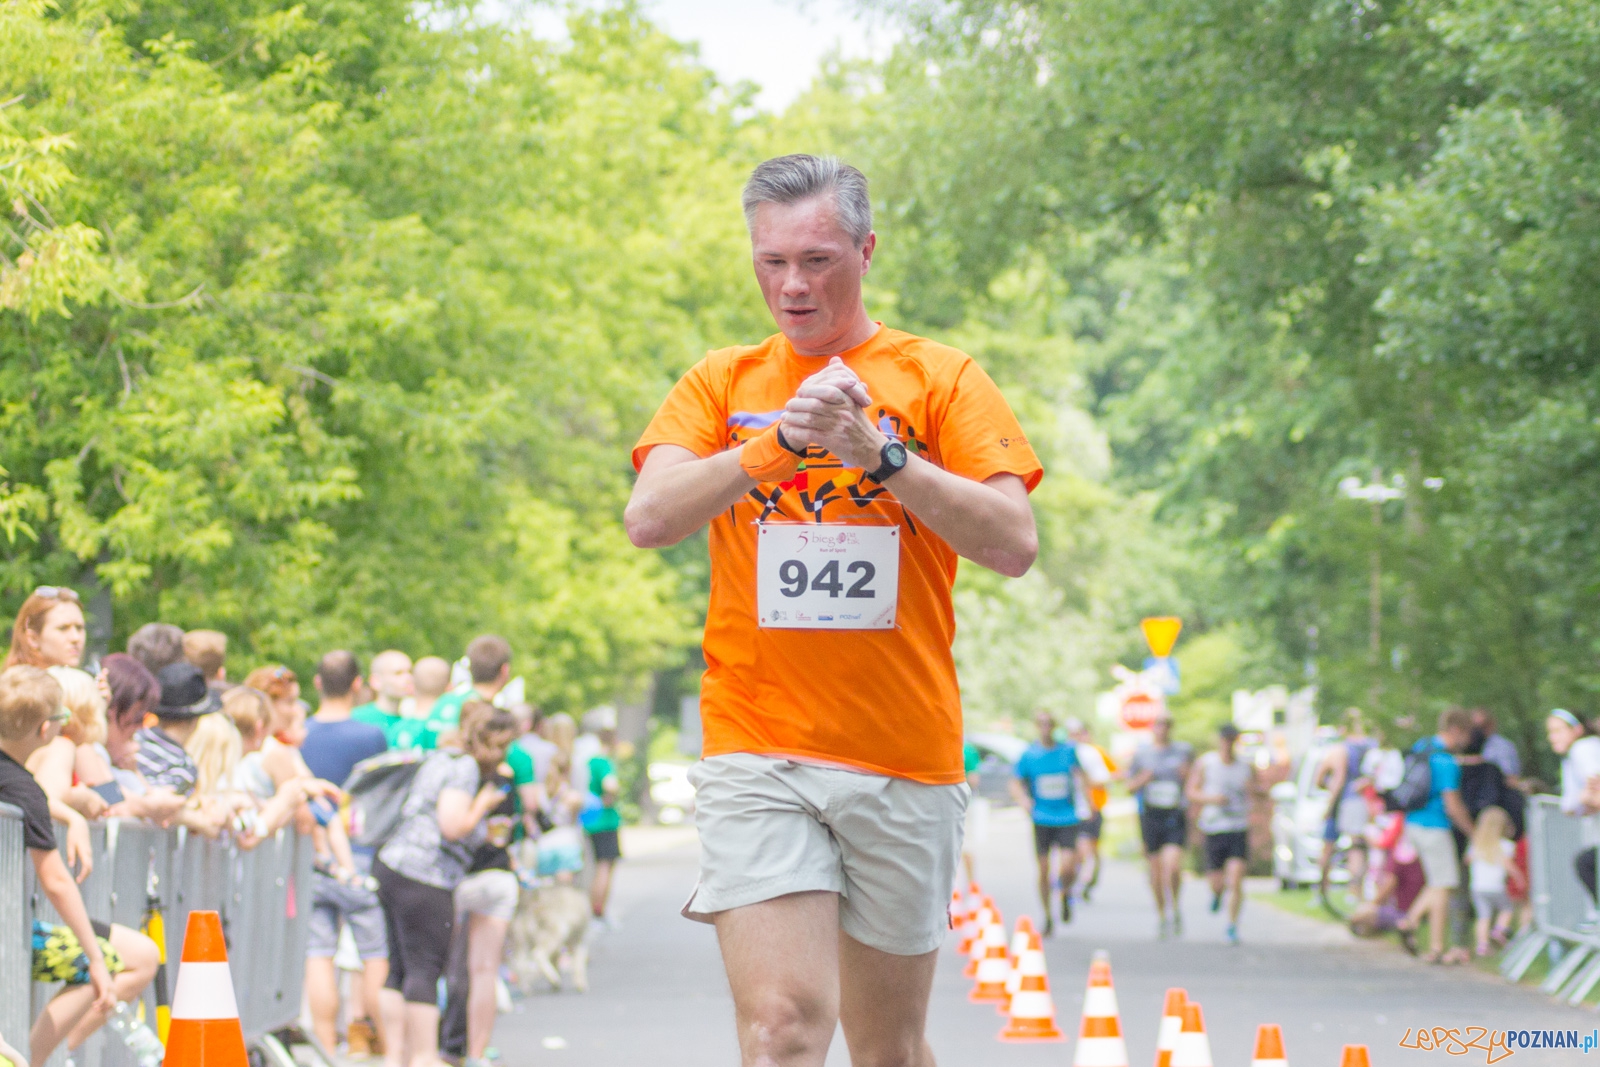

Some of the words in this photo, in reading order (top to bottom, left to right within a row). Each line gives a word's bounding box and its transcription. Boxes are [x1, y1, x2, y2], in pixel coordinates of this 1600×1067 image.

[796, 530, 809, 553] 5
[812, 531, 836, 548] bieg
[779, 559, 876, 599] 942
